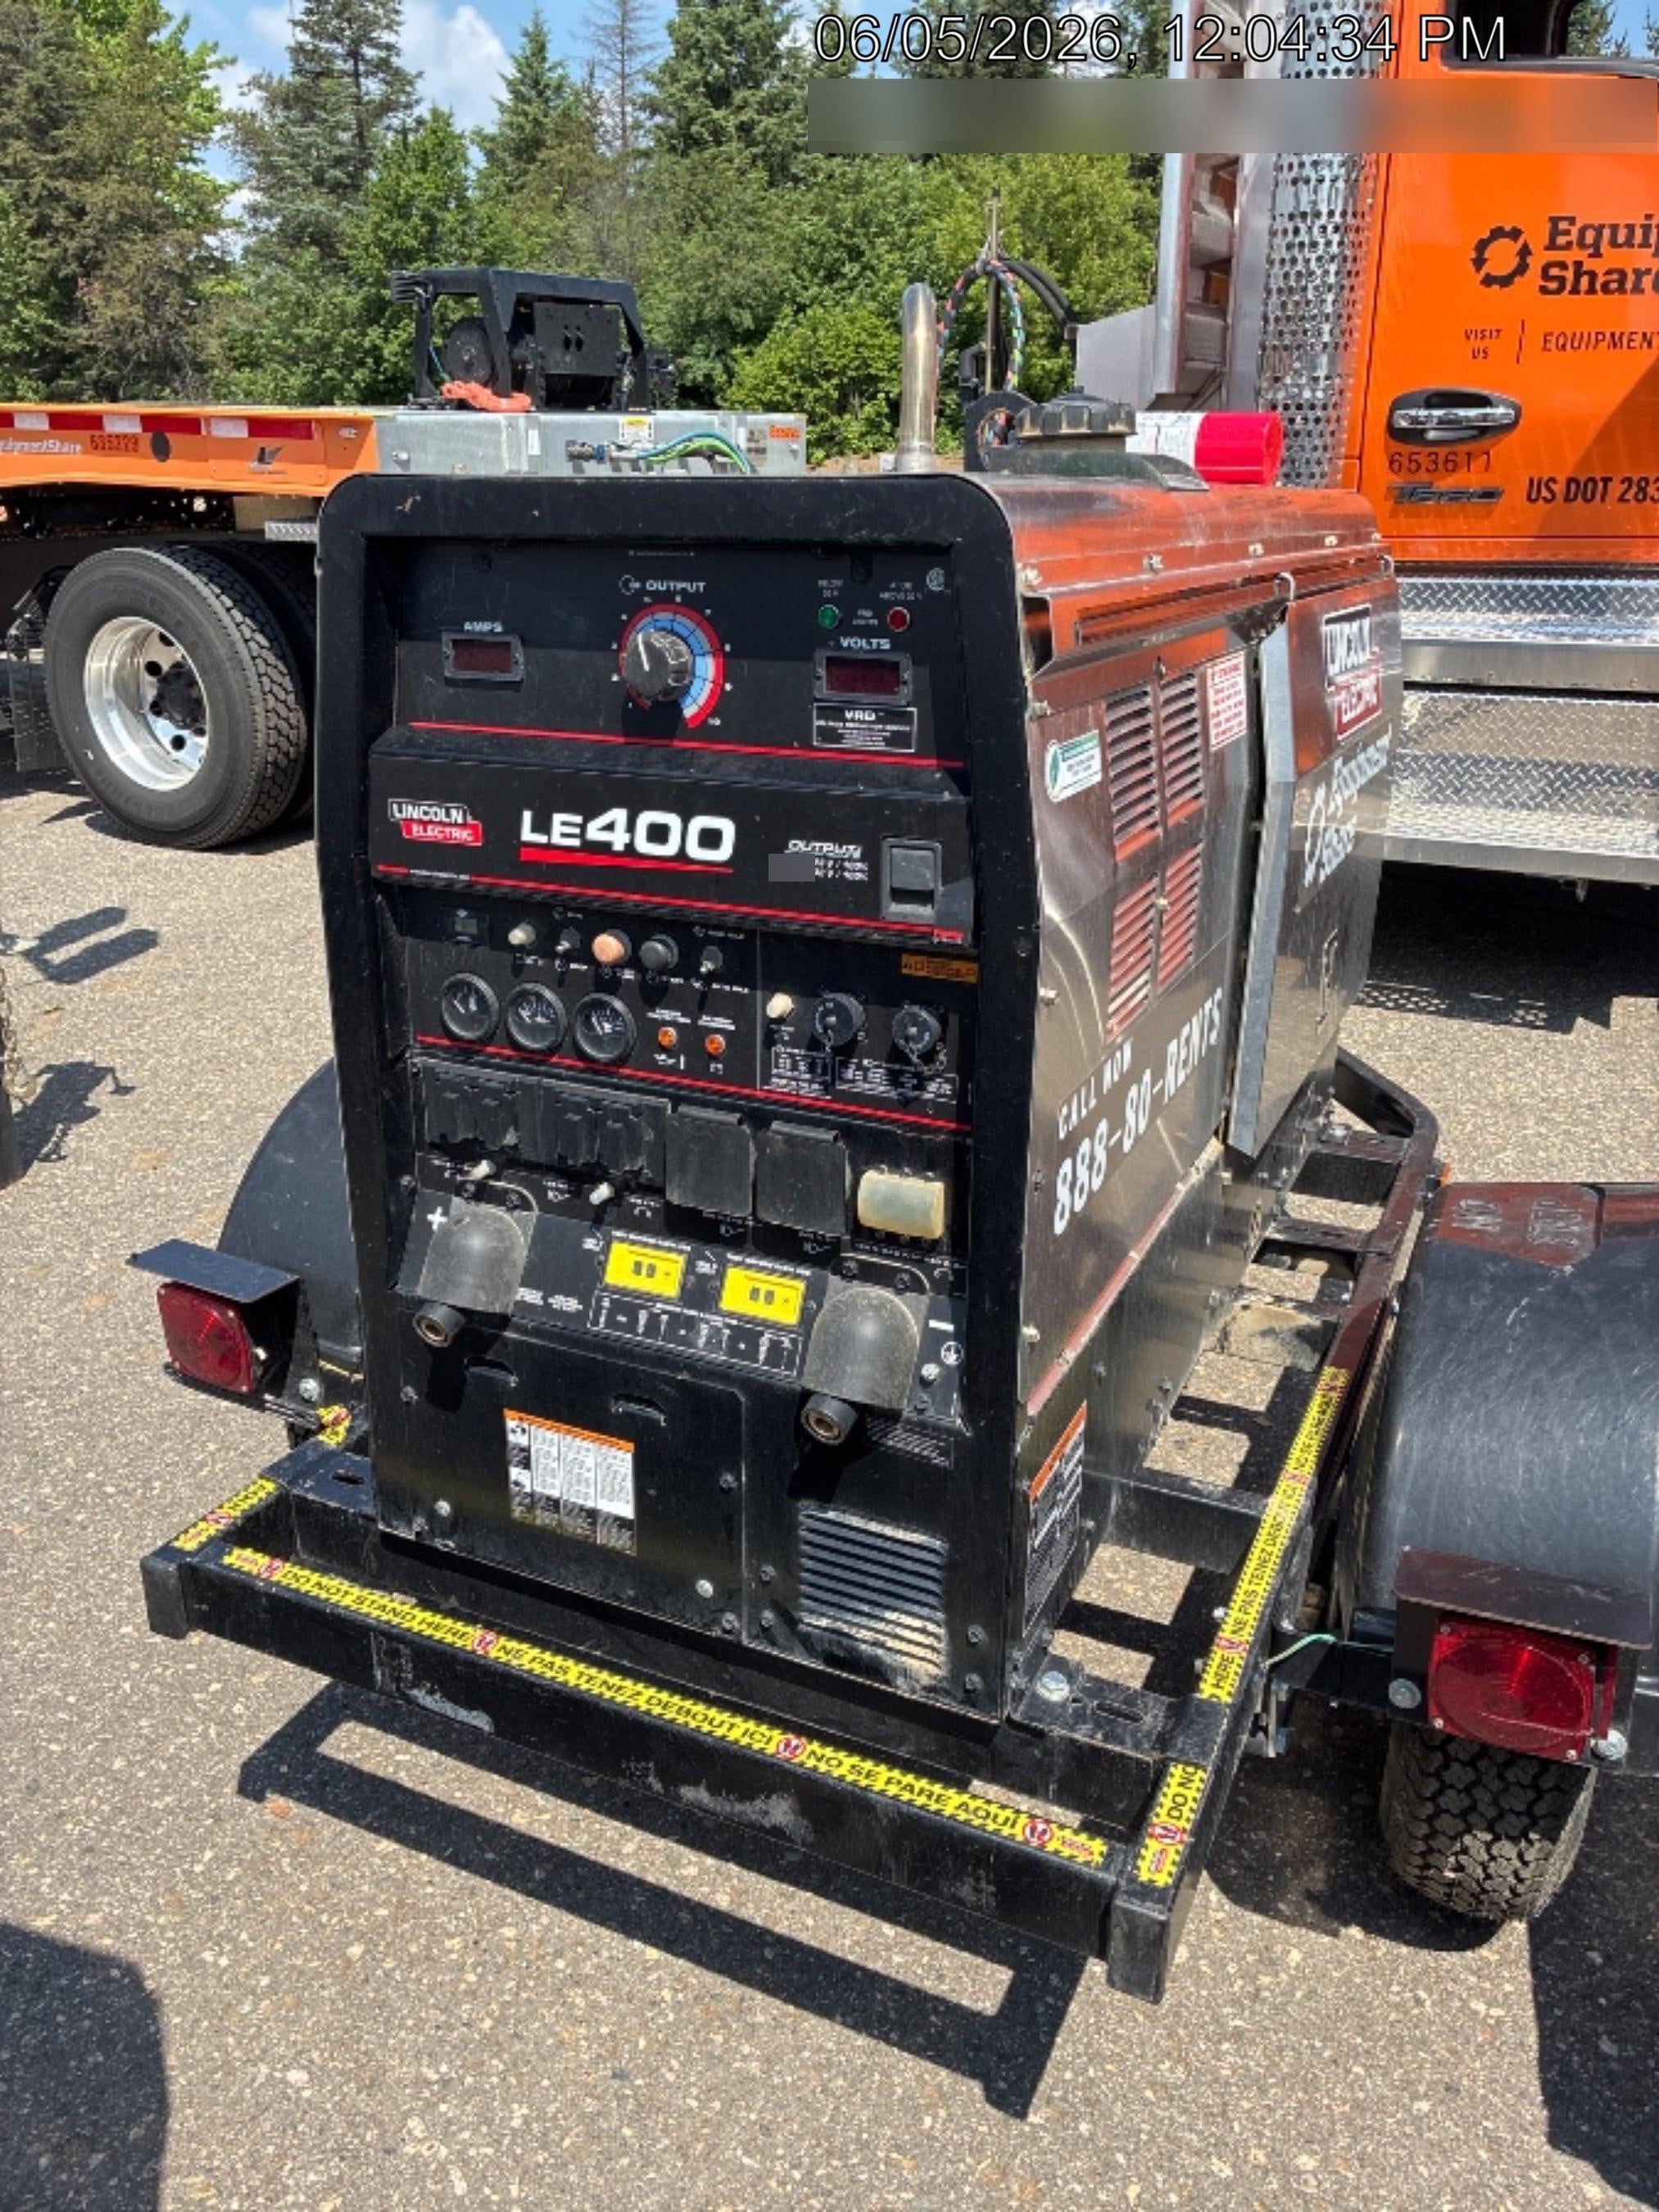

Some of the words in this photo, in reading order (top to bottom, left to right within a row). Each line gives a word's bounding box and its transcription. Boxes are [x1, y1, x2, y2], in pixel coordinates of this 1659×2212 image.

[1543, 213, 1659, 258] Equi
[1464, 329, 1503, 341] VISIT
[1471, 347, 1489, 360] US
[1526, 477, 1557, 504] US
[1563, 477, 1614, 504] DOT
[645, 579, 706, 593] OUTPUT
[463, 620, 504, 633] AMPS
[840, 636, 891, 650] VOLTS
[845, 709, 876, 722] VRD
[392, 802, 464, 823] LINCOLN
[410, 826, 474, 842] ELECTRIC
[520, 808, 736, 863] LE400
[1058, 1077, 1097, 1140] CALL
[1103, 1037, 1133, 1095] NOW
[1054, 987, 1222, 1235] 888-80-RENTS
[281, 1570, 310, 1584] DO
[314, 1581, 354, 1598] NOT
[353, 1595, 416, 1622] STAND
[418, 1616, 475, 1643] HERE
[497, 1643, 528, 1660] NE
[528, 1655, 571, 1677] PAS
[575, 1669, 644, 1700] TENEZ
[645, 1693, 741, 1731] DEBOUT
[741, 1726, 773, 1746] ICI
[806, 1749, 844, 1768] NO
[848, 1764, 879, 1783] SE
[885, 1775, 950, 1806] PARE
[1167, 1793, 1188, 1821] DO
